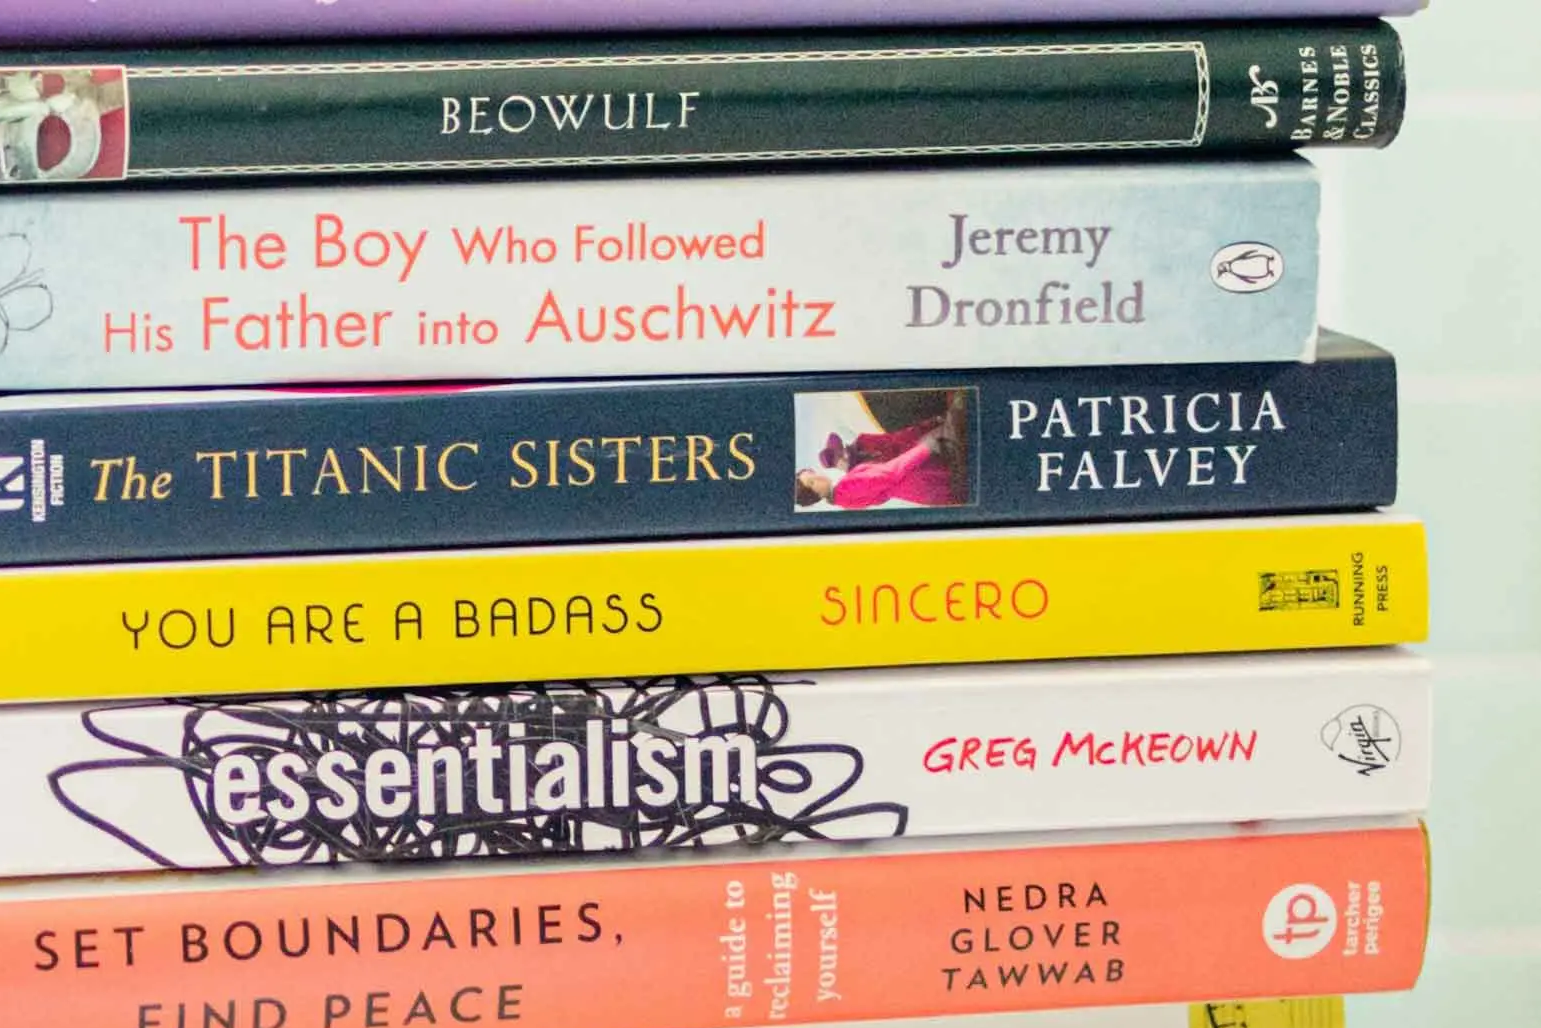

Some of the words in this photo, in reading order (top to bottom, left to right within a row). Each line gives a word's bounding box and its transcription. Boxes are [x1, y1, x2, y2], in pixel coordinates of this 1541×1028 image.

[441, 90, 701, 136] BEOWULF
[1290, 46, 1319, 141] BARNES
[1326, 45, 1351, 123] NOBLE
[1352, 43, 1381, 140] CLASSICS
[1322, 126, 1345, 141] &
[179, 215, 288, 272] The
[315, 213, 428, 284] Boy
[451, 225, 558, 265] Who
[575, 219, 765, 264] Followed
[941, 213, 1113, 271] Jeremy
[103, 311, 175, 354] His
[201, 294, 394, 352] Father
[418, 310, 499, 347] into
[526, 286, 838, 344] Auschwitz
[905, 280, 1147, 330] Dronfield
[1009, 390, 1287, 440] PATRICIA
[31, 439, 46, 522] KENSINGTON
[49, 454, 64, 506] FICTION
[90, 456, 172, 501] The
[196, 441, 481, 499] TITANIC
[510, 432, 756, 487] SISTERS
[1037, 444, 1259, 492] FALVEY
[820, 578, 1050, 627] SINCERO
[1351, 552, 1364, 626] RUNNING
[1376, 565, 1388, 612] PRESS
[121, 607, 235, 650] YOU
[267, 603, 365, 645] ARE
[395, 601, 423, 641] A
[455, 592, 664, 639] BADASS
[212, 718, 759, 825] essentialism
[922, 736, 1037, 773] GREG
[1338, 715, 1392, 777] Virgin
[723, 881, 743, 914] to
[963, 882, 1108, 914] NEDRA
[1342, 880, 1362, 957] tarcher
[1363, 880, 1383, 955] perigee
[34, 925, 146, 972] SET
[182, 902, 624, 963] BOUNDARIES,
[720, 920, 752, 1000] guide
[766, 871, 799, 1021] reclaiming
[809, 887, 841, 1002] yourself
[950, 920, 1122, 955] GLOVER
[942, 958, 1125, 992] TAWWAB
[723, 1006, 742, 1020] a
